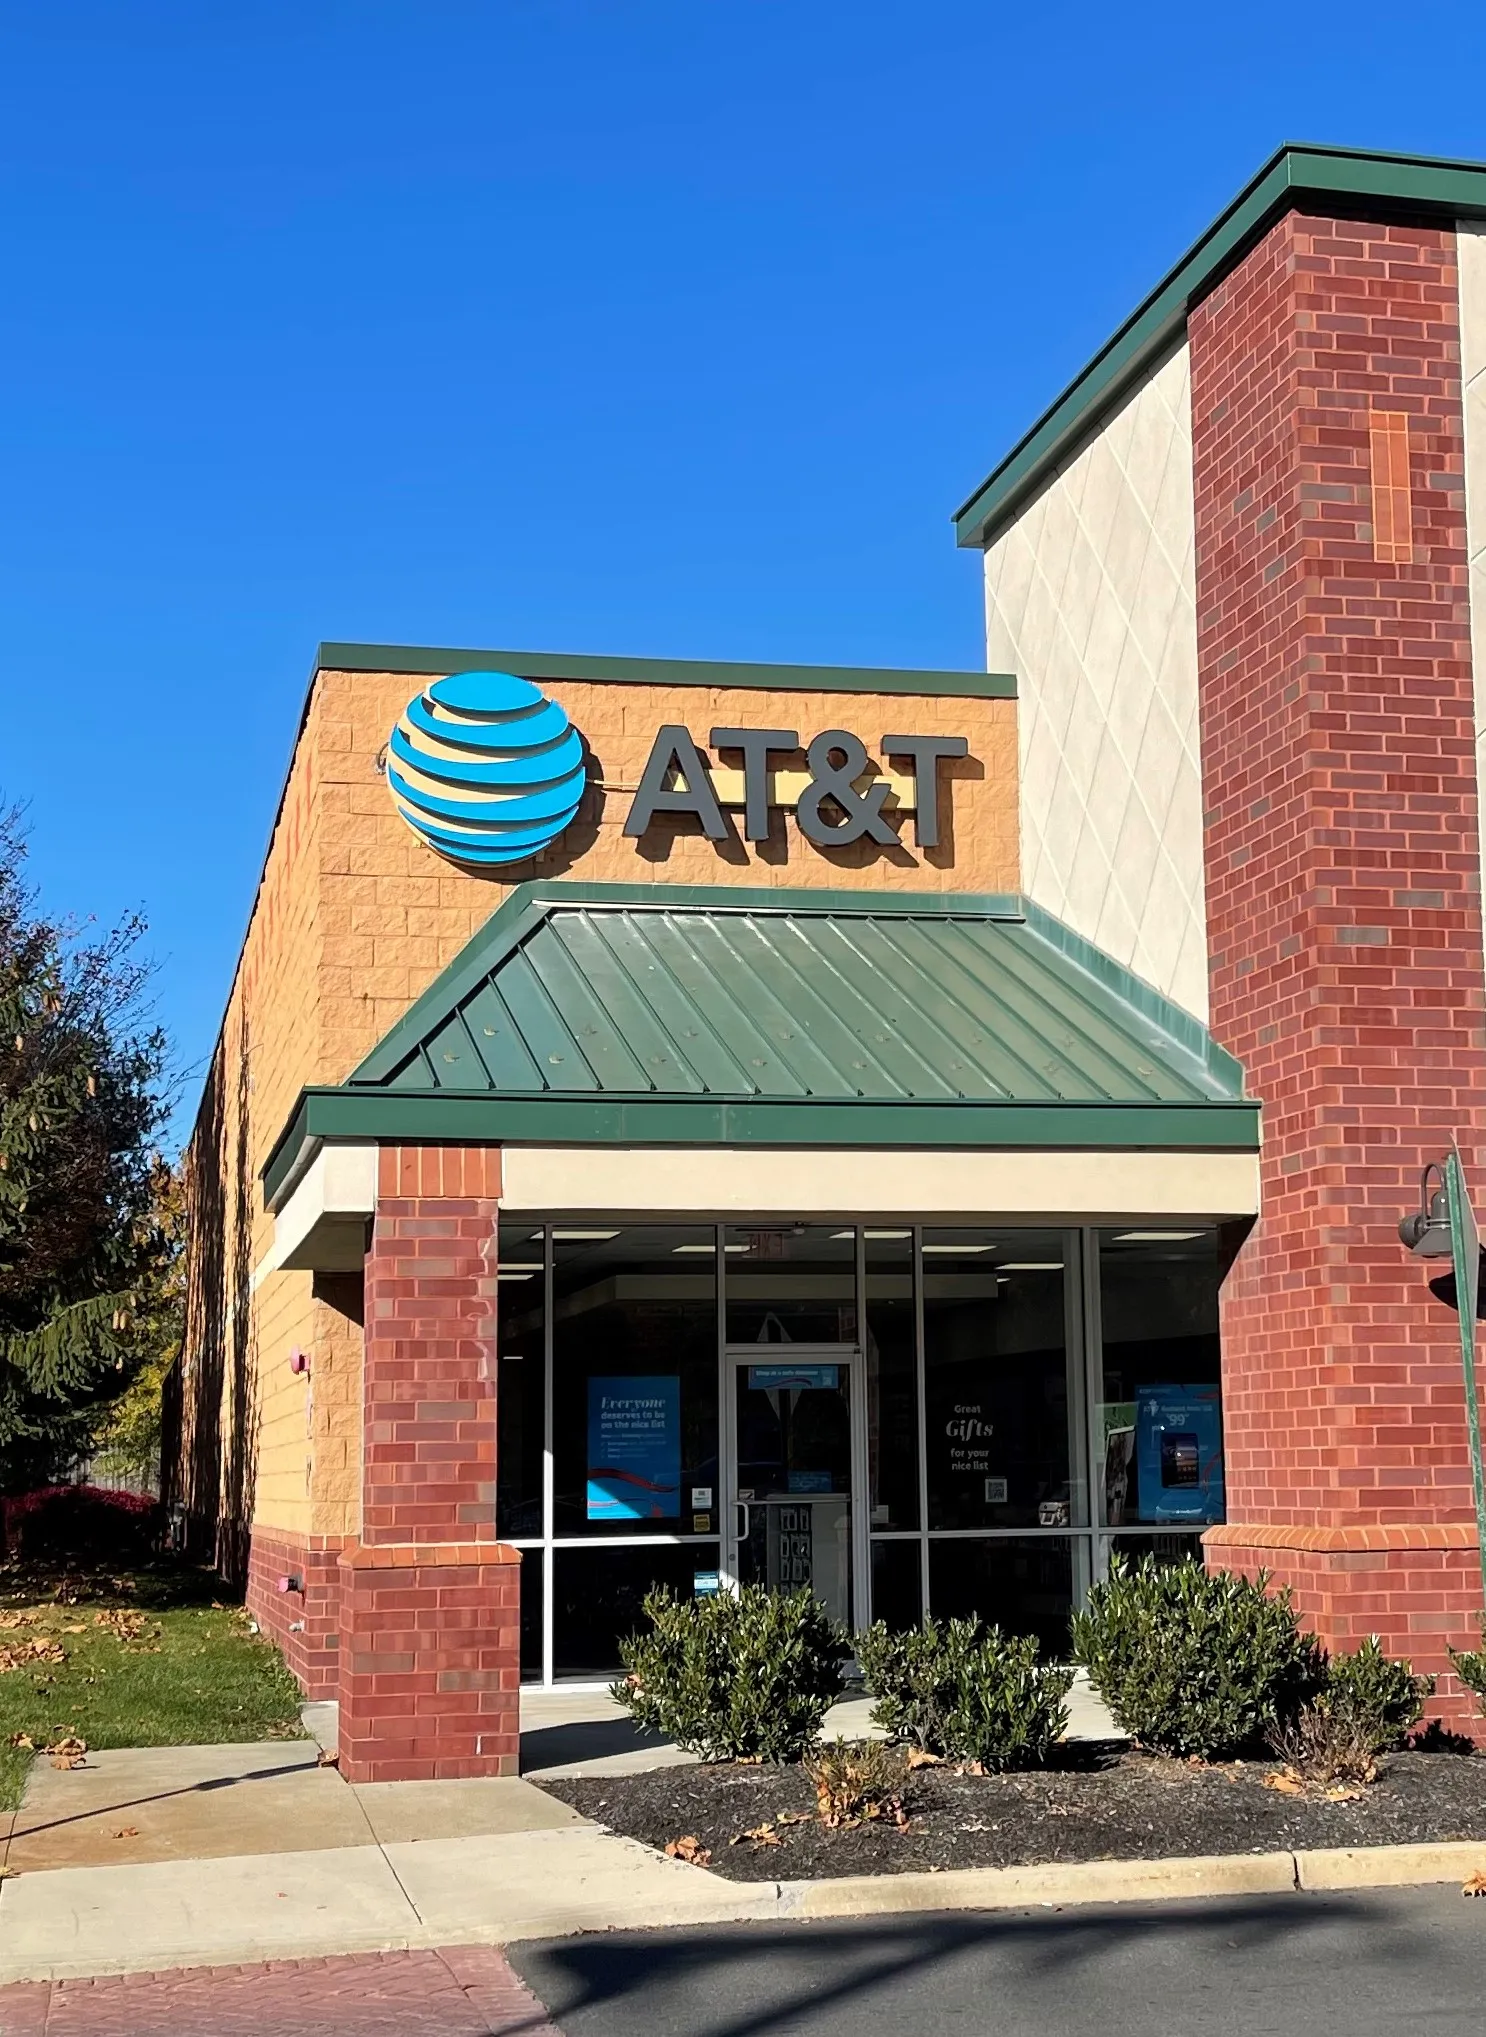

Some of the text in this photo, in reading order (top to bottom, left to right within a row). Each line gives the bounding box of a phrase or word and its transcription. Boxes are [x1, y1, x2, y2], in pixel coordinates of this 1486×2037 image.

[623, 725, 968, 847] AT&T
[601, 1396, 666, 1413] Everyone
[954, 1404, 981, 1414] Great
[601, 1410, 666, 1420] deserves to be
[614, 1421, 629, 1429] the
[631, 1420, 649, 1429] nice
[650, 1419, 666, 1429] list
[945, 1418, 994, 1442] Gifts
[950, 1447, 990, 1460] for your
[951, 1460, 989, 1471] nice list
